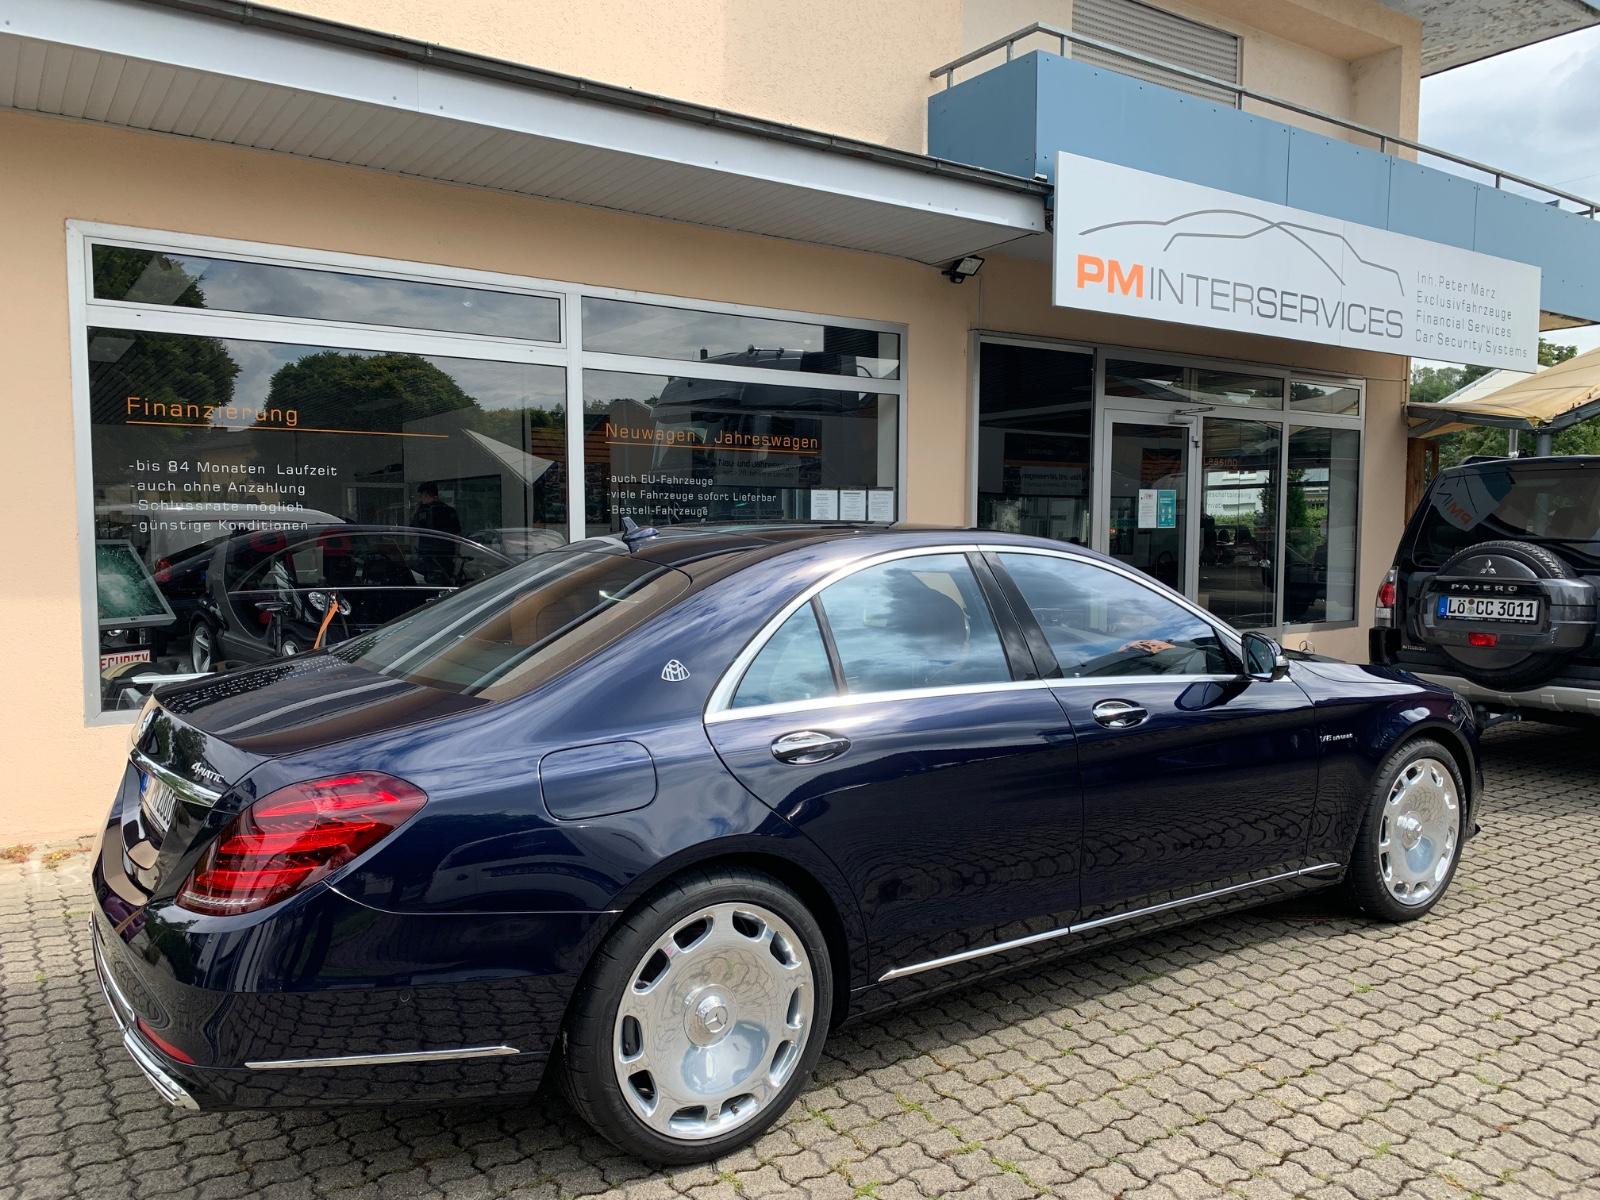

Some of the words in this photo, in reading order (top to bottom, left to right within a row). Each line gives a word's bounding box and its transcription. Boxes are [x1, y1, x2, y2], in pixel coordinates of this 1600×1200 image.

[1439, 275, 1468, 292] Peter
[1417, 290, 1512, 321] Exclusivfahrzeuge
[1416, 309, 1465, 330] Financial
[1468, 319, 1512, 338] Services
[1415, 329, 1434, 343] Car
[1437, 332, 1483, 353] Security
[1485, 340, 1528, 358] Systems
[126, 396, 299, 426] Finanzierung
[605, 422, 696, 444] Neuwagen
[714, 429, 818, 450] Jahreswagen
[168, 460, 190, 473] 84
[197, 461, 266, 475] Monaten
[276, 463, 338, 477] Laufzeit
[183, 480, 221, 493] ohne
[227, 481, 306, 496] Anzahlung
[641, 475, 714, 488] EU-Fahrzeuge
[640, 490, 694, 503] Fahrzeuge
[698, 491, 729, 501] sofort
[733, 492, 777, 503] Lieferbar
[246, 500, 304, 515] möglich
[218, 519, 309, 532] Konditionen
[1450, 583, 1518, 592] PAJERO
[1475, 600, 1494, 616] CC
[1499, 601, 1535, 618] 3011
[99, 652, 149, 670] ECURITY
